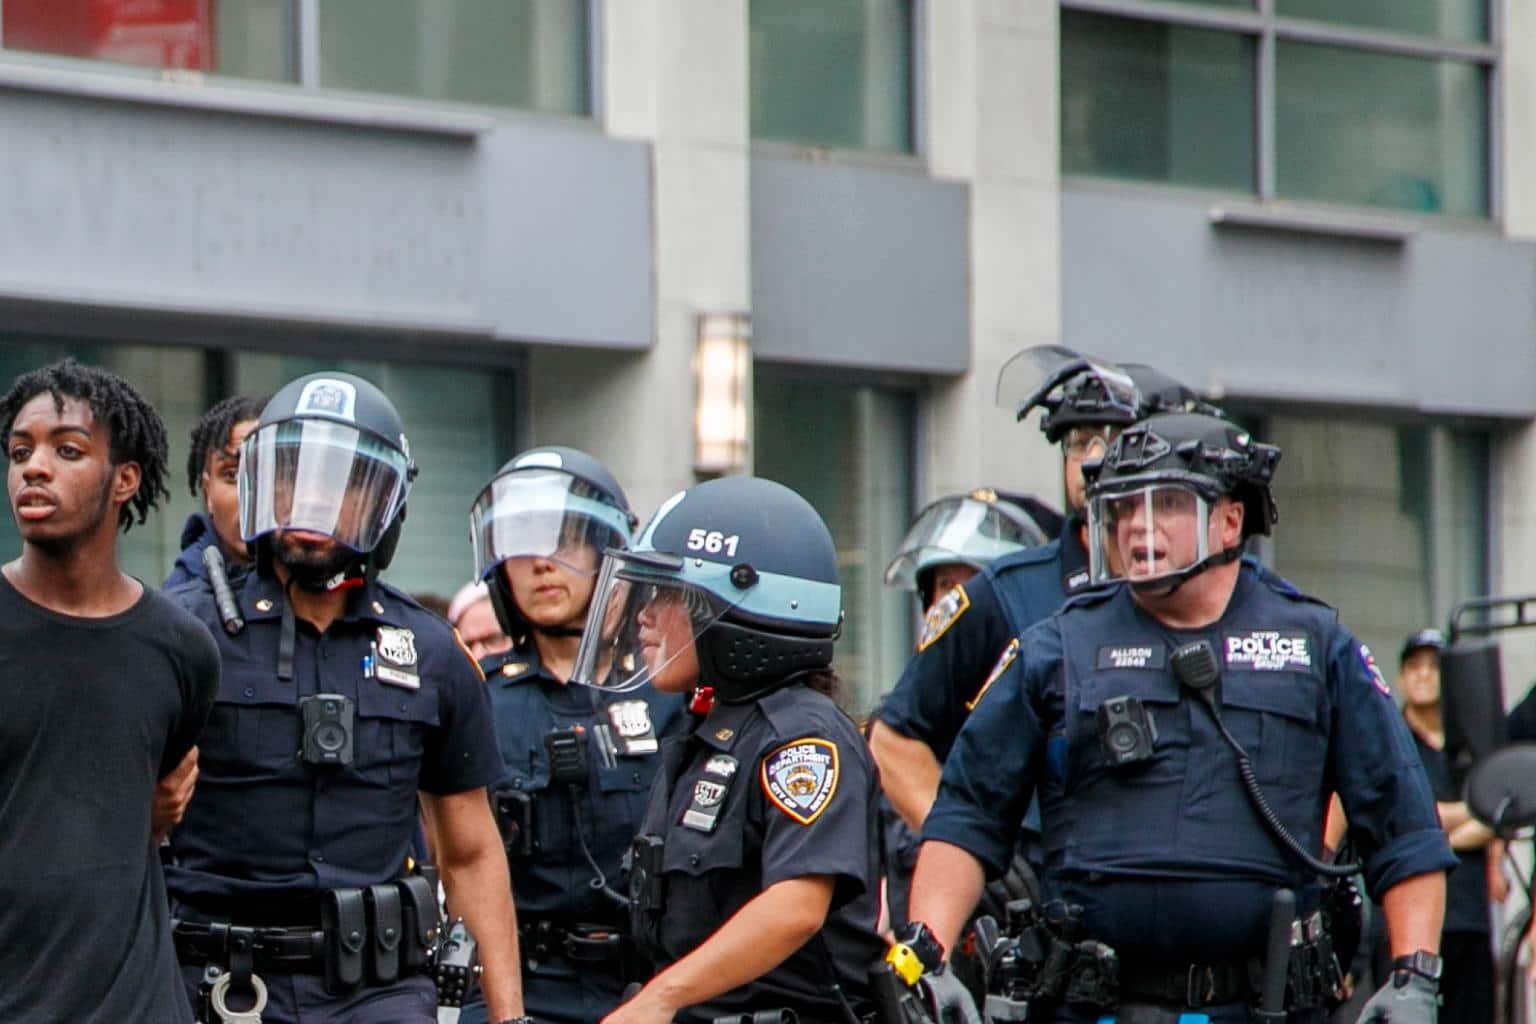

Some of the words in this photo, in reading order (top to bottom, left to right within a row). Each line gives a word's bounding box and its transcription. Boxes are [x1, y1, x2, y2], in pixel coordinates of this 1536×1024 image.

[687, 528, 740, 557] 561
[1227, 636, 1308, 656] POLICE
[779, 745, 816, 760] POLICE
